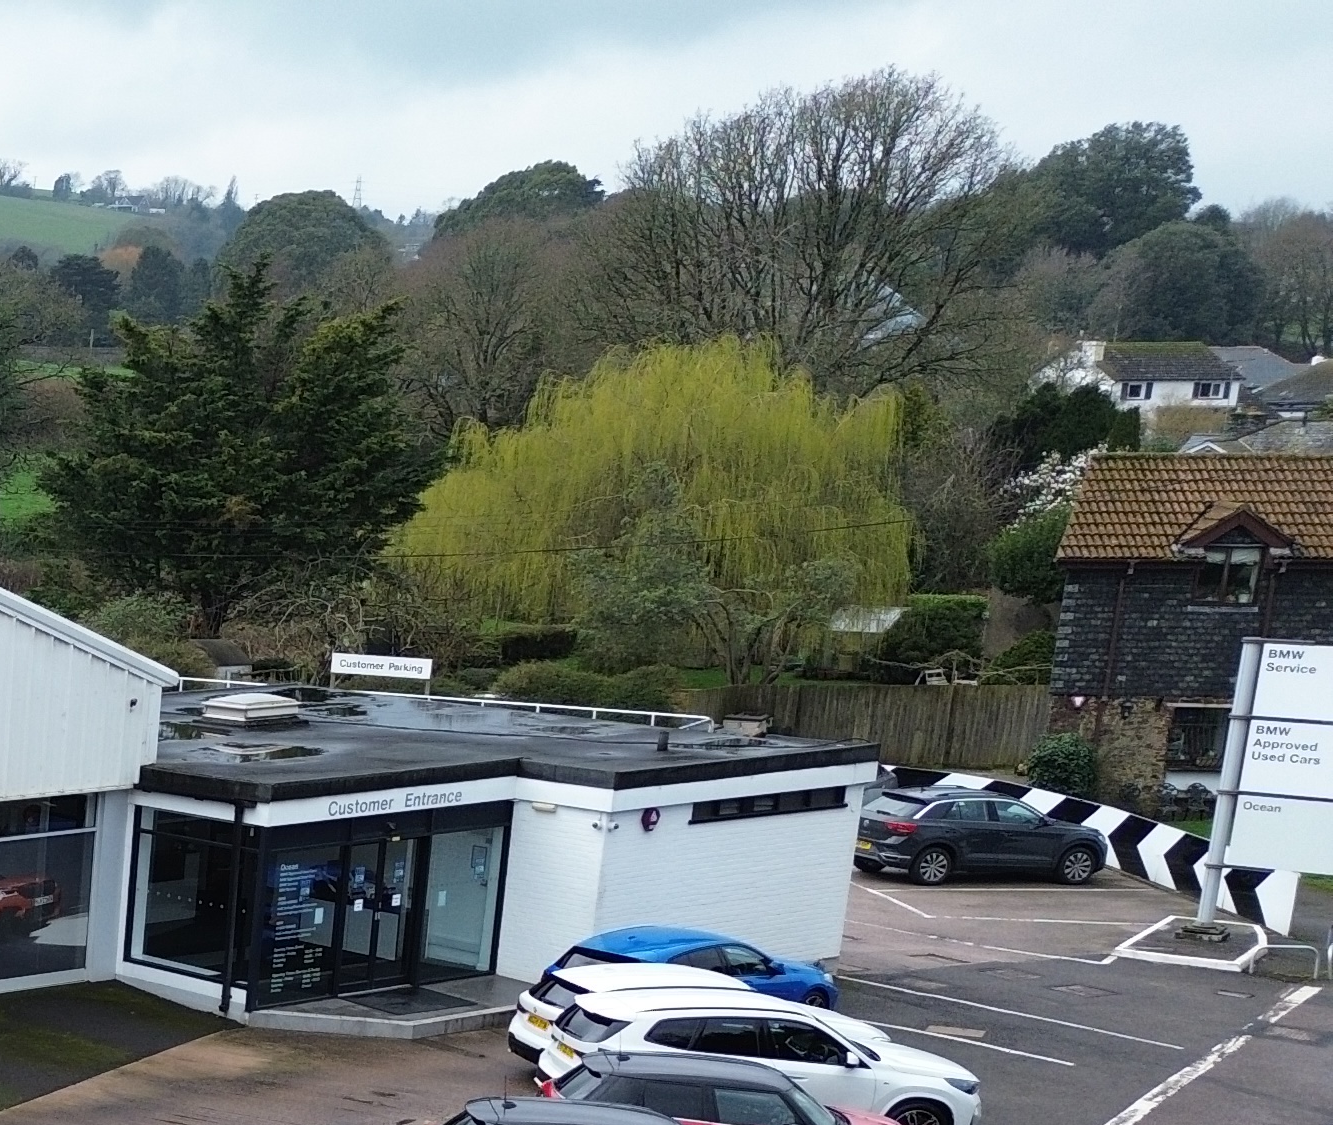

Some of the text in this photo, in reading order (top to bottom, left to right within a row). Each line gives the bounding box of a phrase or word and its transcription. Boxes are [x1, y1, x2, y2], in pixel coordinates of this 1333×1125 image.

[1268, 649, 1305, 660] BMW
[339, 659, 423, 675] Customer Parking
[1265, 662, 1317, 674] Service
[1255, 725, 1291, 736] BMW
[1253, 738, 1318, 751] Approved
[1251, 751, 1321, 765] Used Cars
[328, 790, 463, 816] Customer Entrance
[1243, 801, 1282, 813] Ocean
